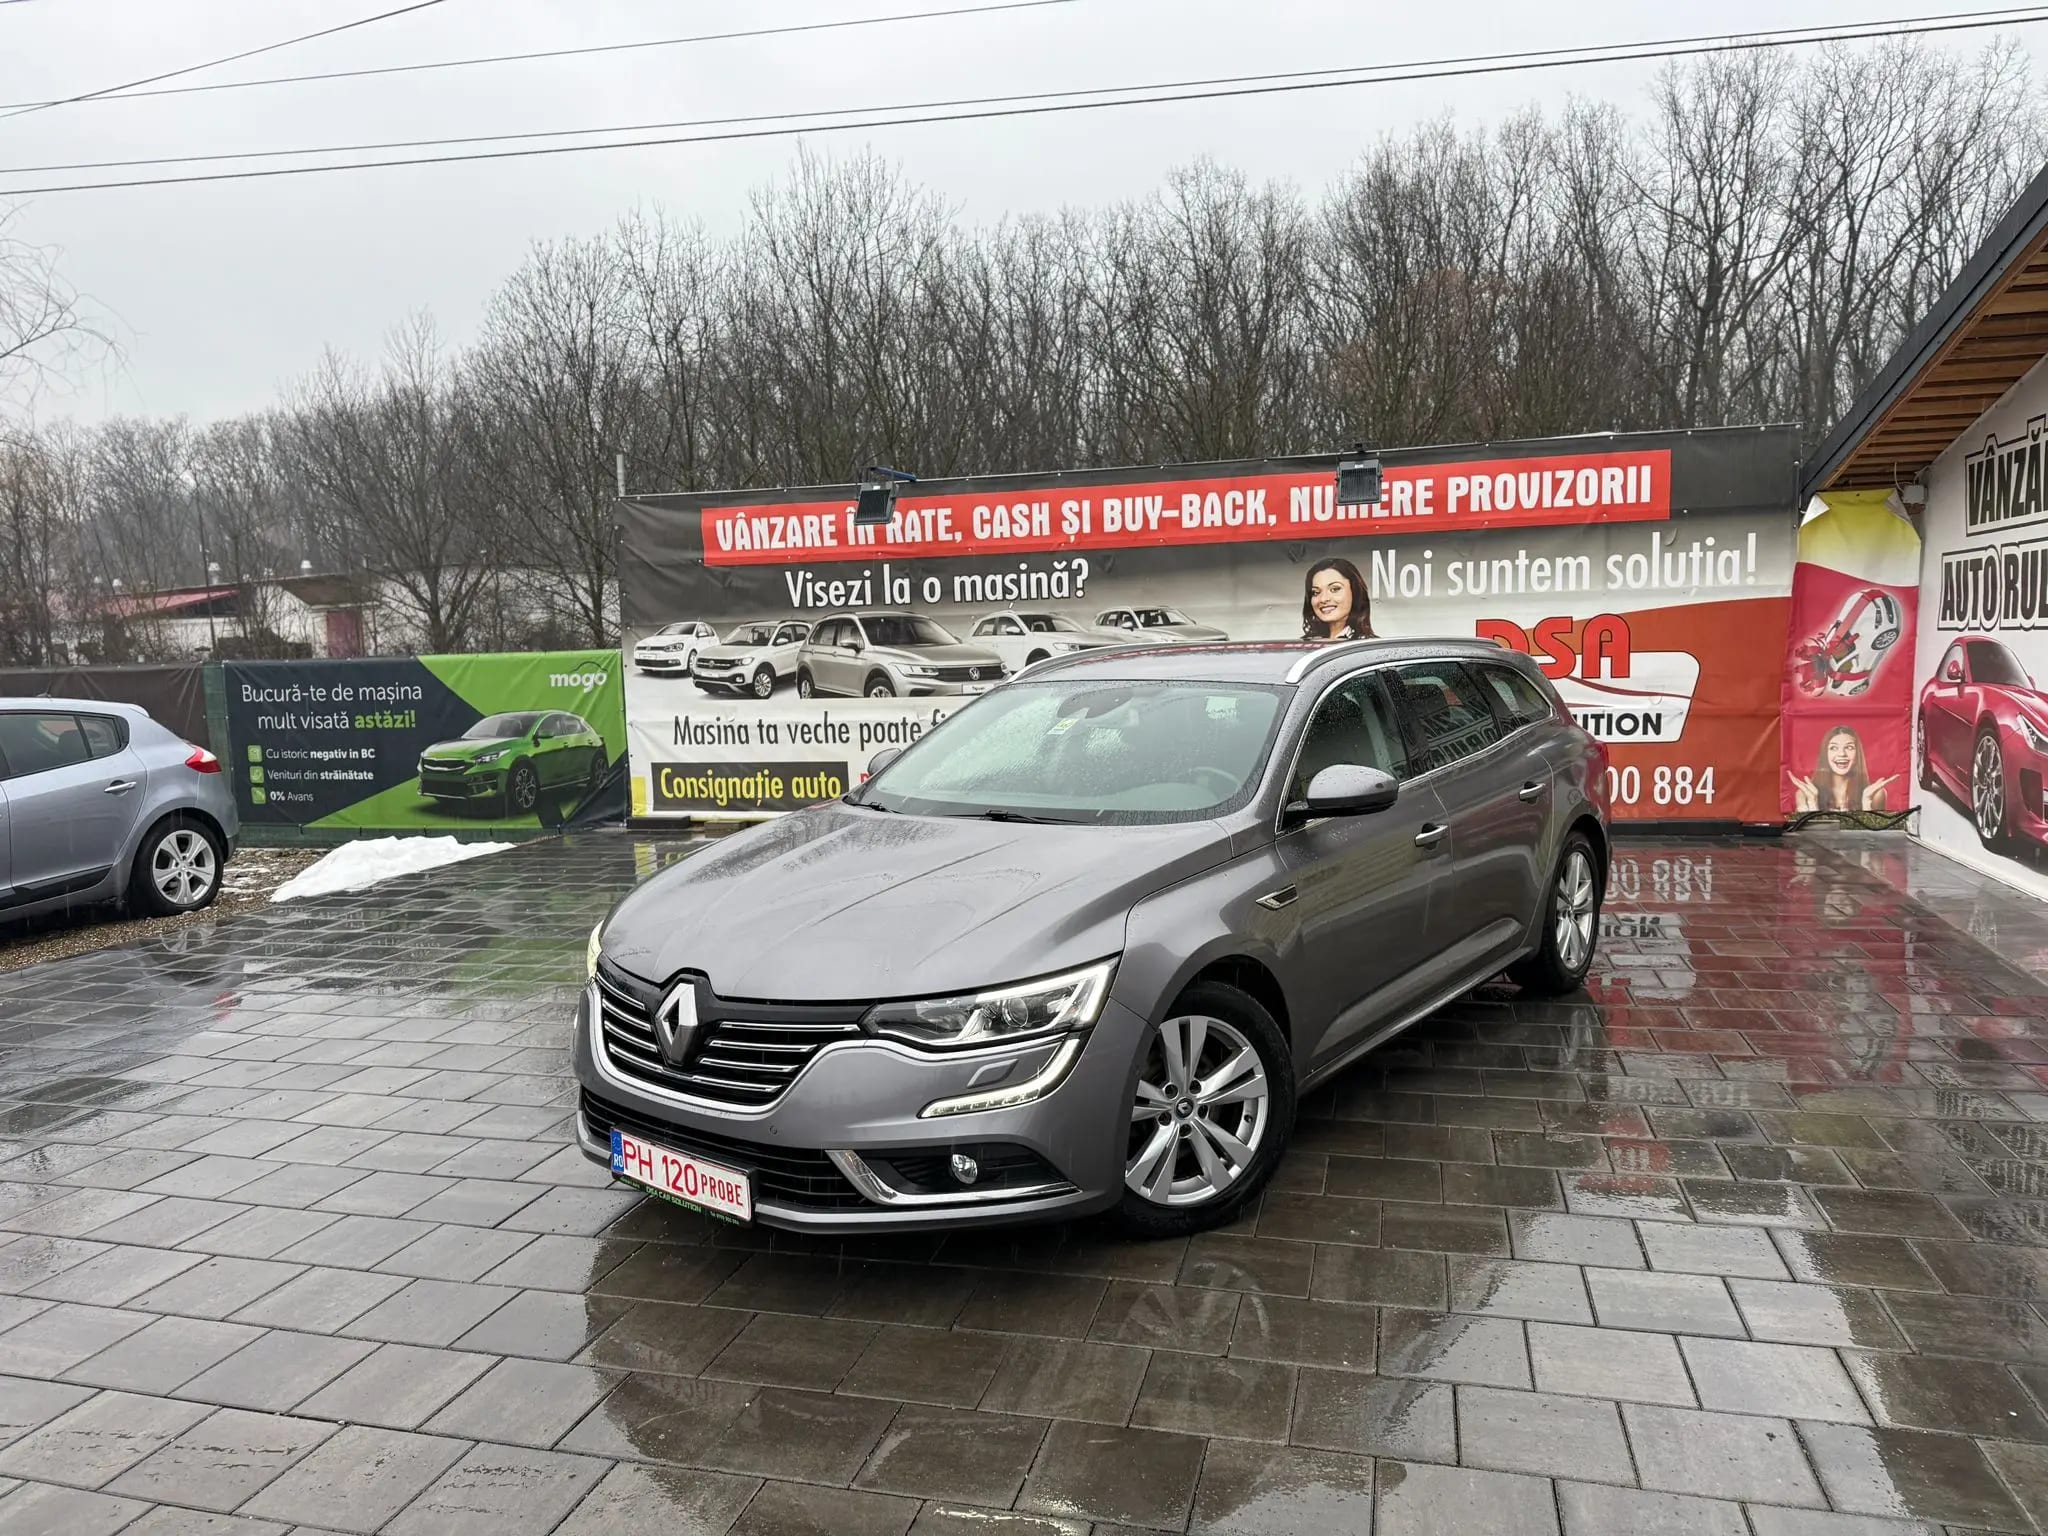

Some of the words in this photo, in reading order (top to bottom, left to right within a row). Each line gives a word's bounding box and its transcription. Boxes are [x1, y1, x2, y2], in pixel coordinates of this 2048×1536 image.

[1968, 426, 2048, 527] VÂNZĂ
[715, 512, 838, 551] VÂNZARE
[886, 507, 962, 544] RATE,
[972, 502, 1050, 540] CASH
[1061, 499, 1092, 543] ȘI
[1103, 488, 1277, 533] BUY-BACK,
[1447, 465, 1652, 514] PROVIZORII
[784, 569, 873, 608] Visezi
[882, 563, 911, 606] la
[922, 576, 942, 604] o
[1371, 549, 1433, 599] Noi
[1446, 549, 1591, 596] suntem
[1940, 555, 1998, 622] AUTO
[241, 684, 327, 703] Bucură-te
[331, 683, 354, 701] de
[359, 682, 423, 705] mașina
[549, 672, 608, 694] mogo
[257, 712, 297, 730] mult
[300, 711, 350, 730] visată
[354, 709, 417, 729] astăzi!
[757, 718, 779, 744] ta
[787, 710, 850, 744] veche
[859, 716, 923, 752] poate
[265, 748, 280, 760] Cu
[281, 747, 309, 760] istoric
[310, 748, 348, 762] negativ
[361, 748, 376, 760] BC
[267, 769, 302, 781] Venituri
[303, 769, 319, 781] din
[319, 769, 375, 781] străinătate
[270, 790, 286, 802] 0%
[286, 791, 314, 802] Avans
[660, 767, 784, 808] Consignație
[790, 771, 842, 800] auto
[1653, 765, 1716, 805] 884
[613, 1153, 625, 1169] RO
[623, 1138, 654, 1181] PH
[661, 1154, 699, 1197] 120
[700, 1173, 744, 1207] PROBE
